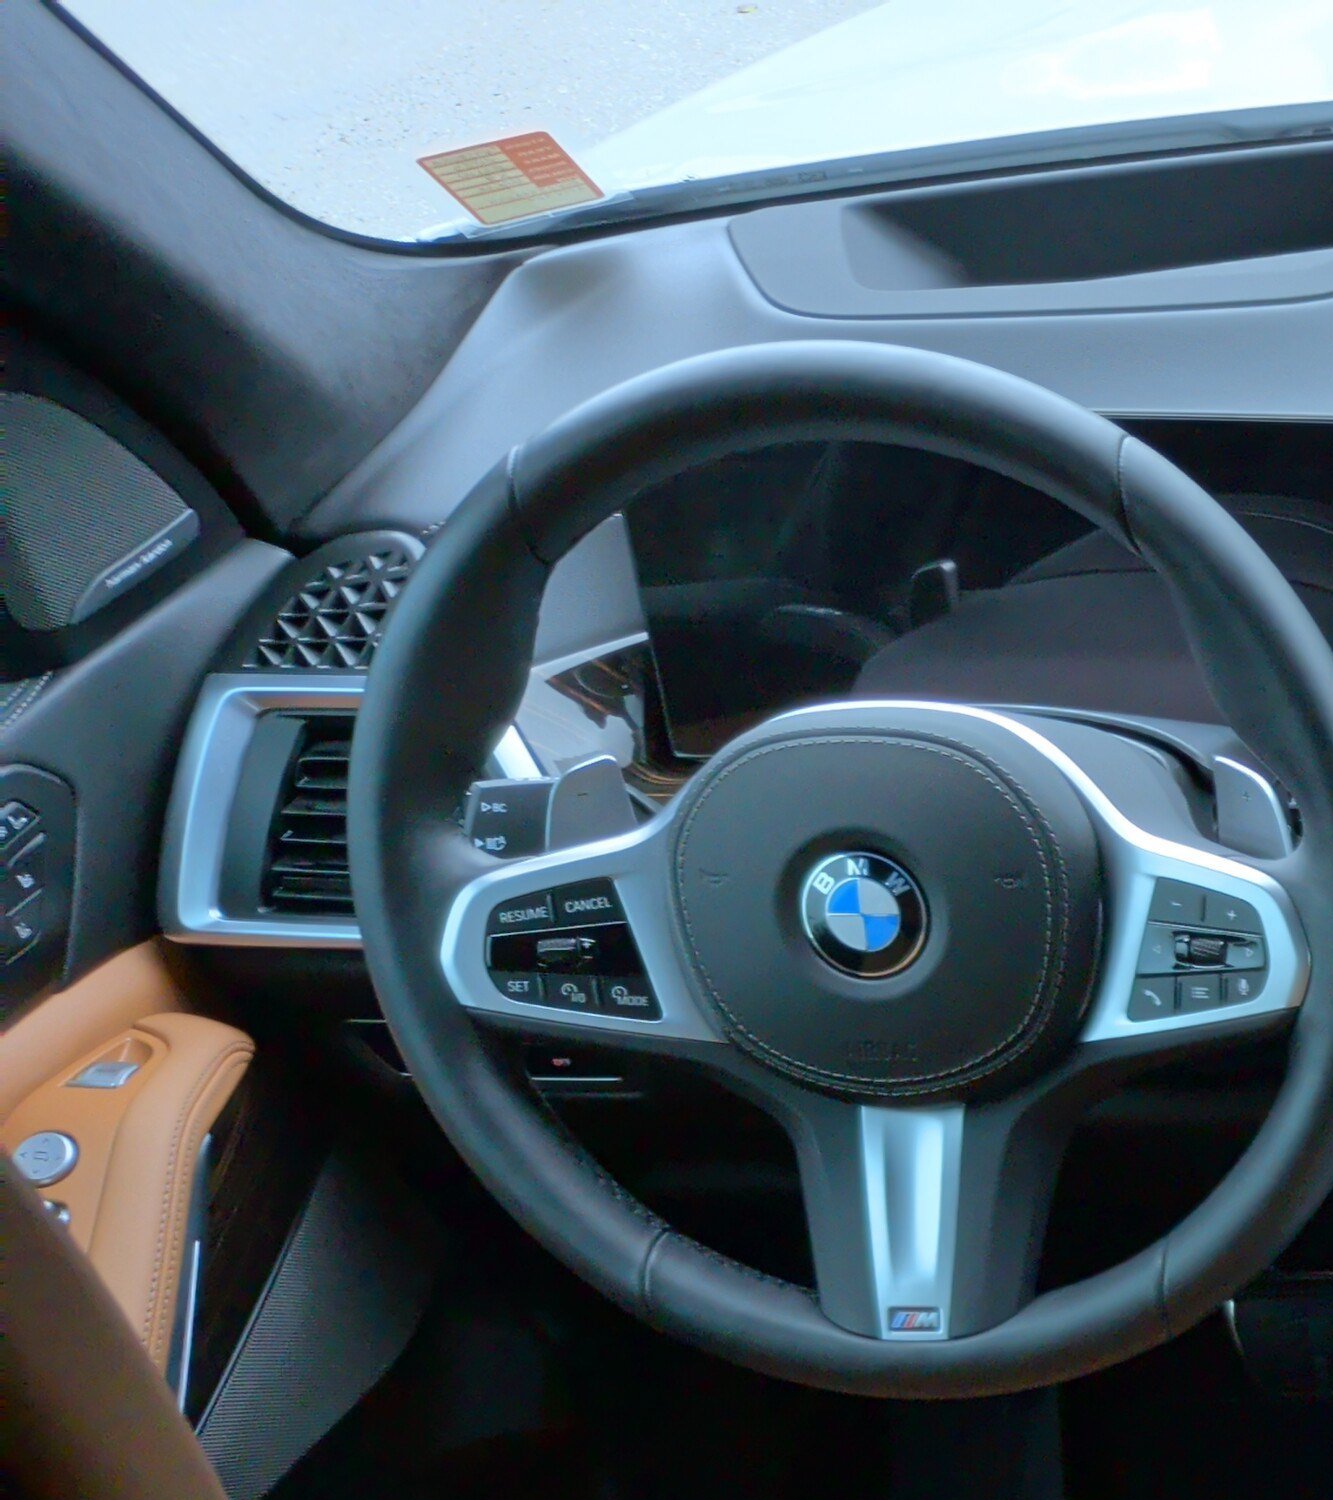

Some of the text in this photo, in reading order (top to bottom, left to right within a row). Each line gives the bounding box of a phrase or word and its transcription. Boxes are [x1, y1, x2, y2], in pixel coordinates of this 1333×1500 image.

[812, 857, 911, 897] BMW
[565, 896, 613, 914] CANCEL
[499, 906, 550, 924] RESUME
[507, 981, 530, 993] SET
[616, 995, 649, 1007] MODE
